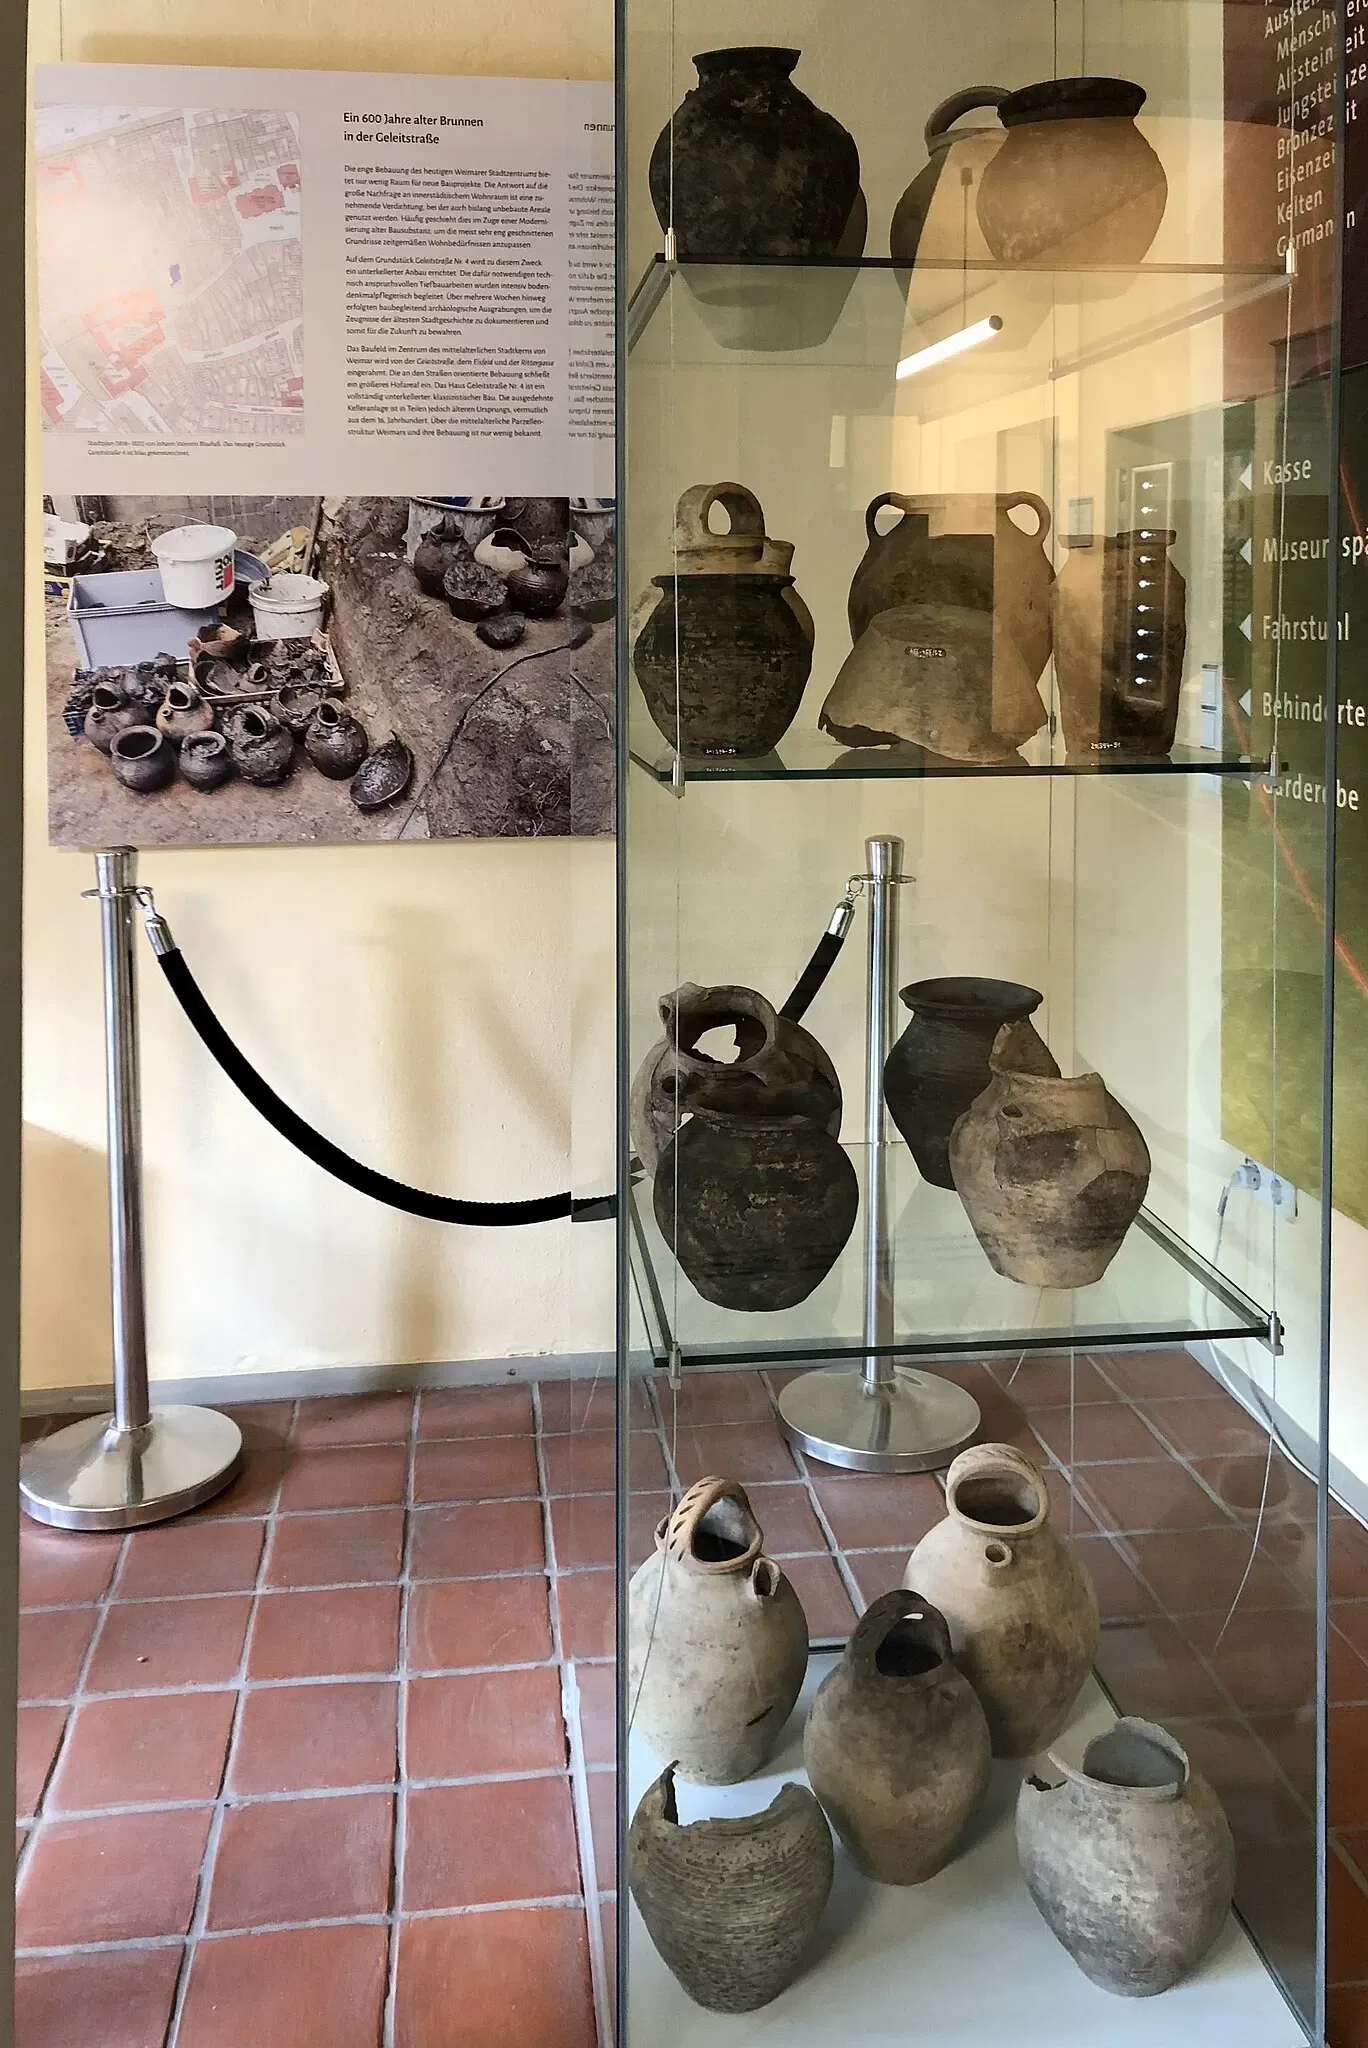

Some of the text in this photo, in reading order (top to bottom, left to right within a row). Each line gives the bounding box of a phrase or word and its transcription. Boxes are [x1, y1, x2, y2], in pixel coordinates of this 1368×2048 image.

[343, 112, 484, 127] Ein 600 Jahre alter Brunnen
[344, 131, 440, 144] in der Geleitstraße
[344, 164, 355, 172] Die
[357, 166, 373, 174] enge
[375, 165, 409, 175] Bebauung
[410, 166, 421, 174] des
[423, 167, 453, 177] heutigen
[488, 168, 536, 177] Stadtzentrums
[1277, 142, 1336, 193] Eisenzei
[368, 177, 388, 187] wenig
[390, 178, 409, 186] Raum
[411, 178, 421, 186] für
[484, 180, 495, 188] Die
[496, 180, 524, 189] Antwort
[525, 181, 536, 189] auf
[537, 181, 548, 189] die
[366, 189, 401, 199] Nachfrage
[471, 192, 508, 200] Wohnraum
[345, 201, 381, 209] nehmende
[438, 203, 449, 211] der
[450, 203, 466, 211] auch
[492, 204, 528, 212] unbebaute
[1277, 189, 1323, 225] Kelten
[424, 215, 456, 224] geschieht
[483, 216, 499, 225] Zuge
[345, 225, 370, 234] sierung
[371, 225, 386, 233] alter
[446, 227, 456, 235] die
[458, 227, 476, 235] meist
[477, 227, 492, 236] sehr
[345, 237, 381, 245] Grundrisse
[427, 238, 491, 247] Wohnbedürfnissen
[346, 255, 357, 263] Auf
[358, 255, 374, 263] dem
[375, 256, 413, 264] Grundstück
[470, 257, 485, 265] wird
[495, 257, 519, 266] diesem
[346, 267, 356, 275] ein
[357, 267, 403, 275] unterkellerter
[404, 268, 426, 276] Anbau
[460, 269, 471, 277] Die
[472, 269, 490, 277] dafür
[491, 269, 534, 279] notwendigen
[419, 280, 472, 289] Tiefbauarbeiten
[474, 281, 499, 289] wurden
[346, 290, 412, 301] denkmalpflegerisch
[463, 292, 492, 301] mehrere
[493, 293, 520, 301] Wochen
[521, 293, 545, 303] hinweg
[346, 303, 377, 312] erfolgten
[541, 305, 552, 313] die
[380, 315, 391, 323] der
[421, 316, 473, 325] Stadtgeschichte
[535, 317, 549, 325] und
[366, 326, 376, 334] für
[389, 327, 417, 335] Zukunft
[347, 344, 359, 352] Das
[360, 344, 386, 352] Baufeld
[398, 345, 427, 353] Zentrum
[428, 345, 440, 353] des
[441, 345, 496, 354] mittelalterlichen
[374, 356, 389, 364] wird
[404, 357, 415, 365] der
[457, 357, 471, 365] dem
[494, 358, 507, 366] und
[508, 358, 519, 366] der
[389, 368, 400, 376] Die
[489, 369, 522, 379] Bebauung
[347, 380, 357, 388] ein
[434, 381, 446, 389] Das
[448, 381, 465, 389] Haus
[534, 381, 545, 389] ein
[499, 393, 510, 401] Die
[360, 415, 376, 423] dem
[448, 416, 458, 424] die
[460, 416, 509, 425] mittelalterliche
[407, 428, 420, 436] und
[421, 428, 434, 436] ihre
[436, 428, 469, 438] Bebauung
[492, 428, 512, 438] wenig
[1263, 459, 1312, 484] Kasse
